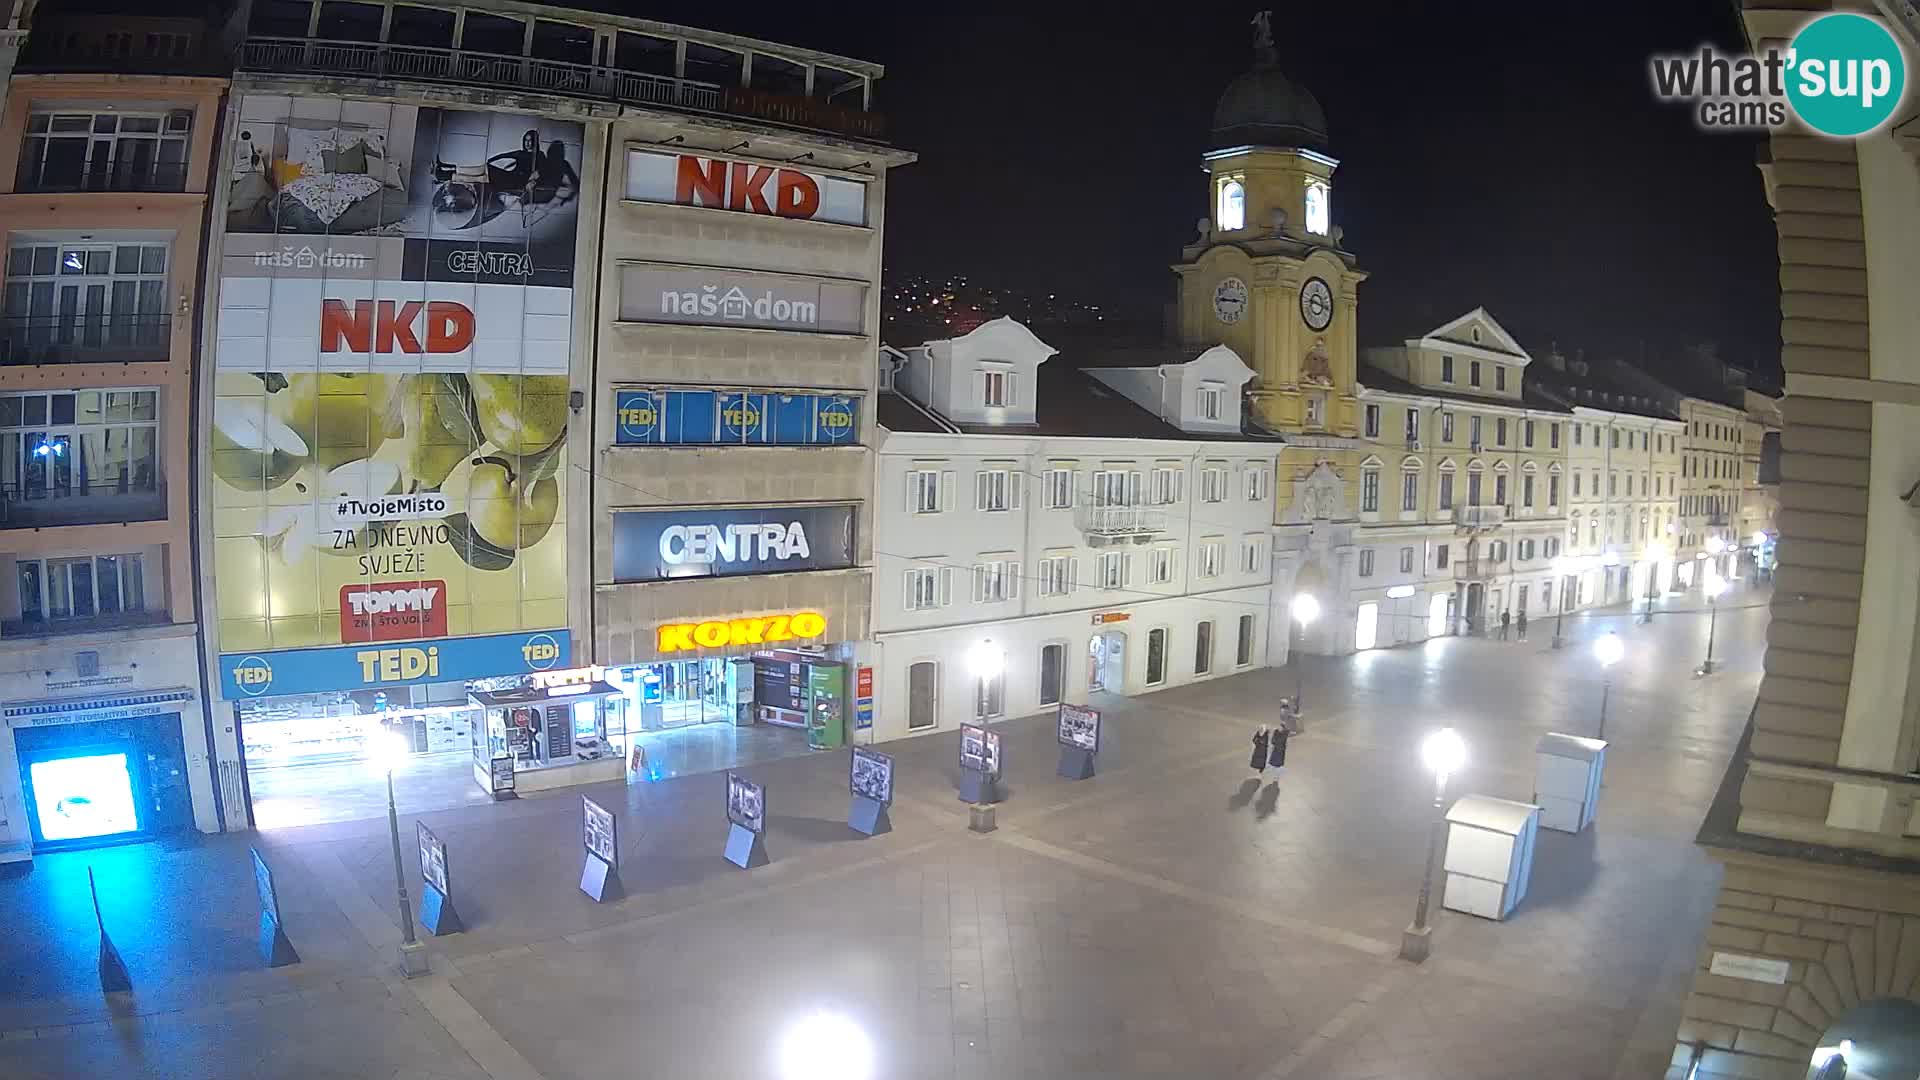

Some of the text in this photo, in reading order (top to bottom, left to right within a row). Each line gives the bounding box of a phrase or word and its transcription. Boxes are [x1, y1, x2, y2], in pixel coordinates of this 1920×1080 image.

[675, 155, 820, 219] NKD
[447, 250, 534, 276] CENTRA
[319, 299, 476, 354] NKD
[619, 408, 657, 426] TEDi
[723, 410, 760, 426] TEDi
[820, 411, 853, 428] TEDi
[337, 497, 446, 517] #TvojeMisto
[333, 524, 450, 549] ZA DNEVNO
[659, 521, 810, 565] CENTRA
[359, 548, 425, 576] SVJEŽE
[347, 587, 438, 615] TOMMY
[402, 611, 431, 625] VOŠ
[657, 613, 825, 652] KORZO
[357, 646, 439, 683] TEDi
[522, 643, 560, 661] TEDi
[233, 667, 273, 685] TEDi
